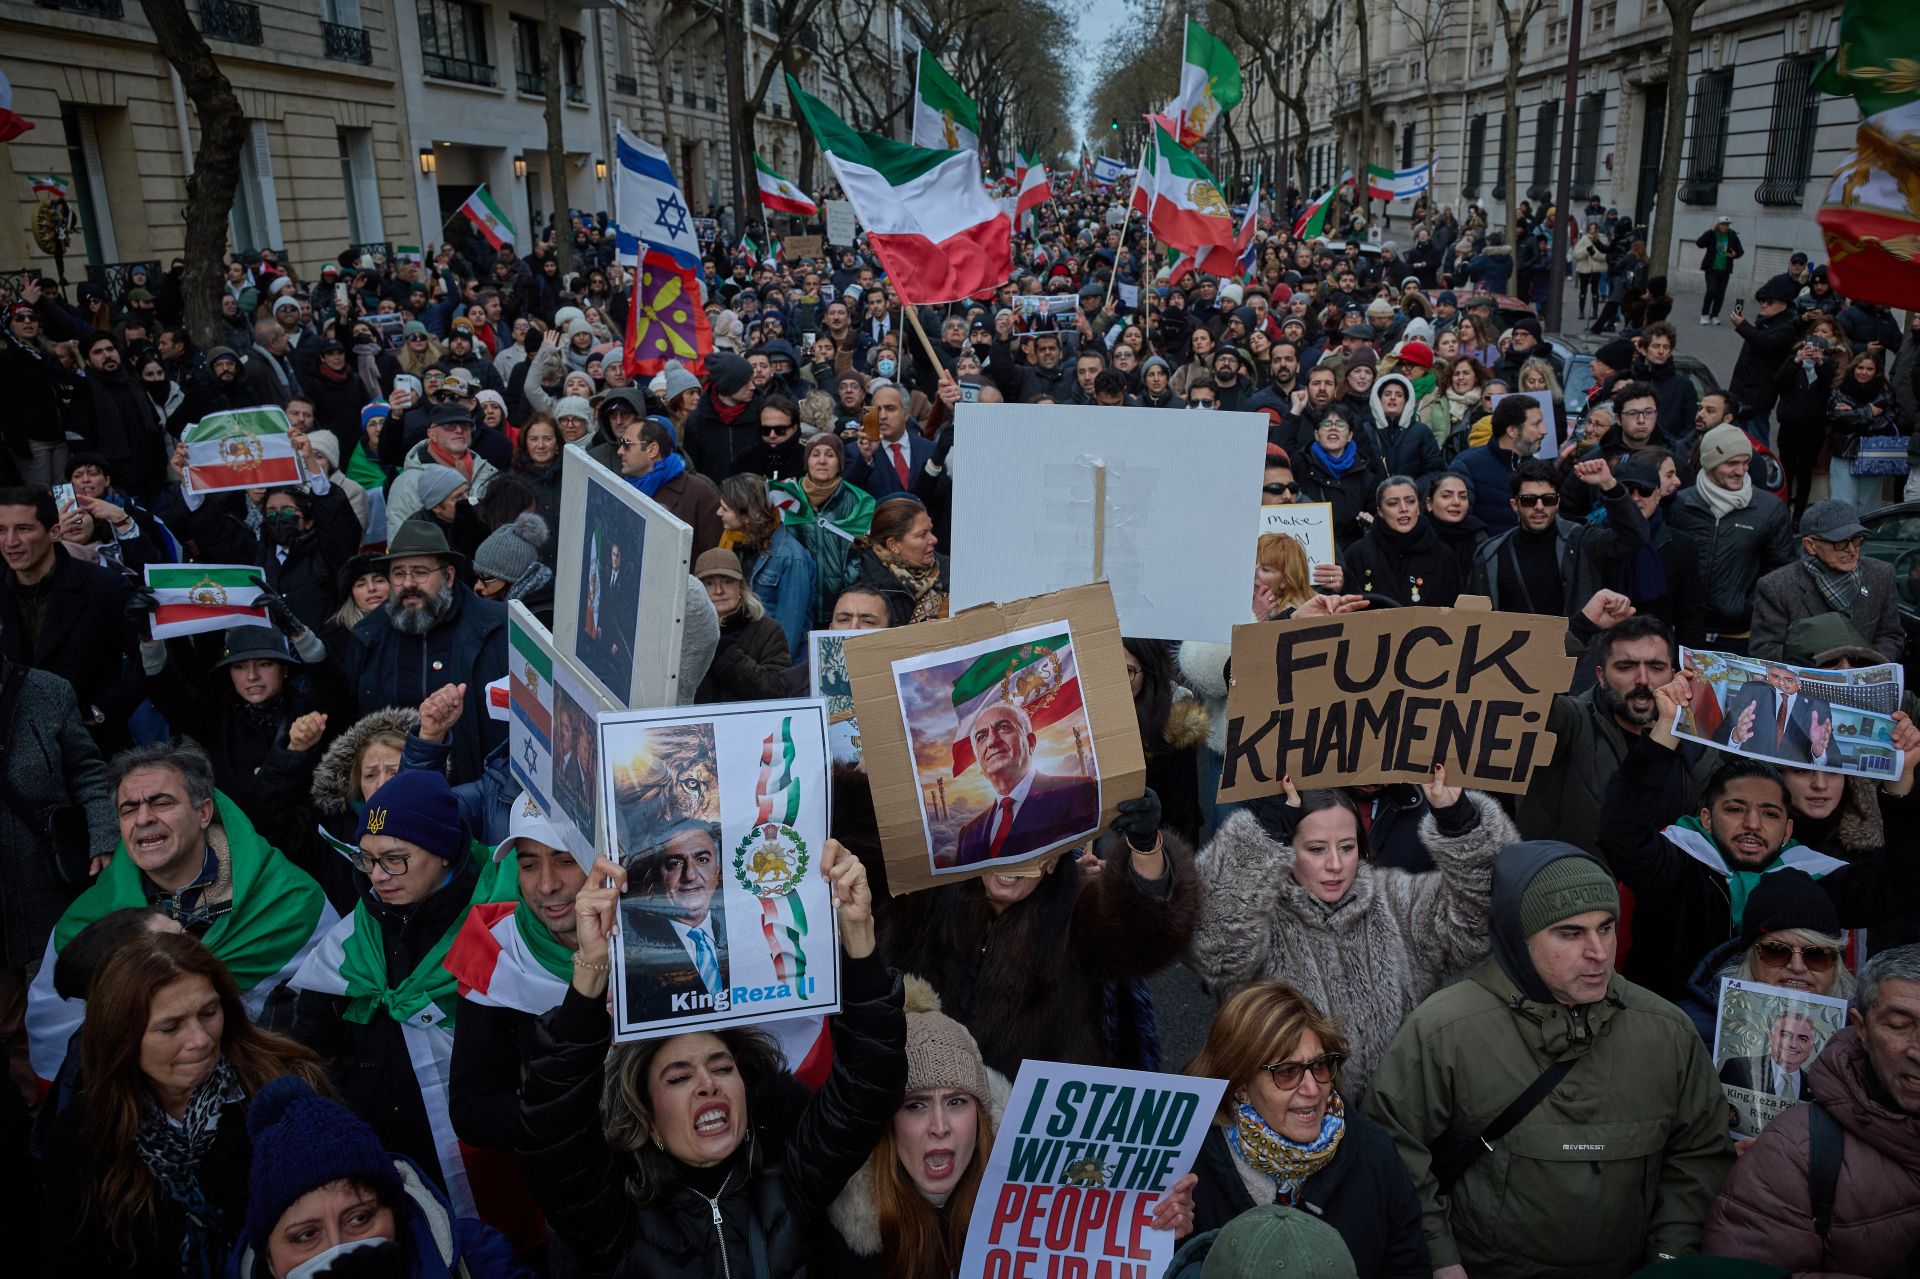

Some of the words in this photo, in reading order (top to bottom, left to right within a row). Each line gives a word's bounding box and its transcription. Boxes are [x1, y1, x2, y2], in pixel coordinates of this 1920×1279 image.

[1276, 621, 1540, 705] FUCK
[671, 988, 731, 1012] King
[732, 982, 791, 1005] Reza
[1019, 1078, 1050, 1135] I
[1046, 1080, 1200, 1148] STAND
[1727, 1088, 1749, 1103] King
[1006, 1136, 1111, 1186] WITH
[1109, 1146, 1182, 1192] THE
[987, 1183, 1161, 1262] PEOPLE
